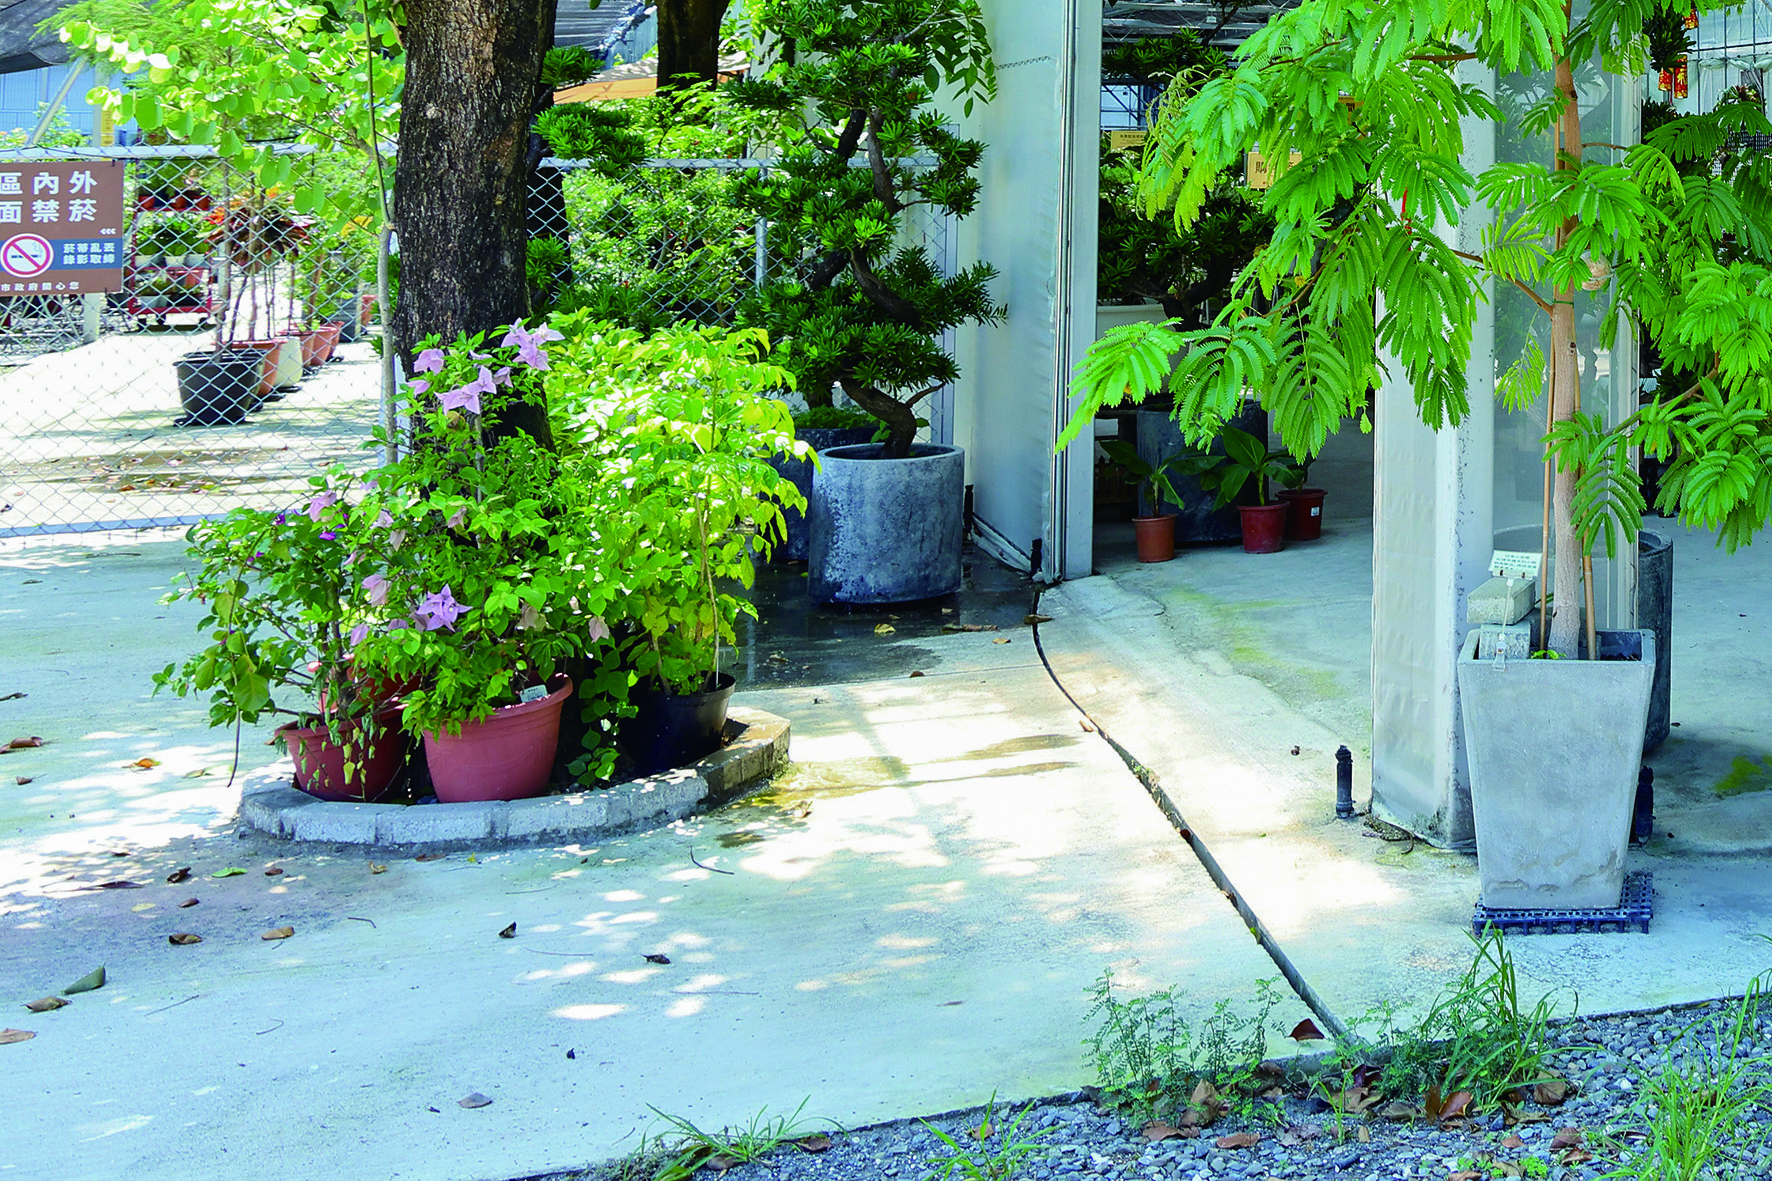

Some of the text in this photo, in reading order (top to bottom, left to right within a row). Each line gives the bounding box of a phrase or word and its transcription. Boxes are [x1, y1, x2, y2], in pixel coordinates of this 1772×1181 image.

[0, 170, 98, 195] 區內外
[0, 199, 98, 224] 面禁菸
